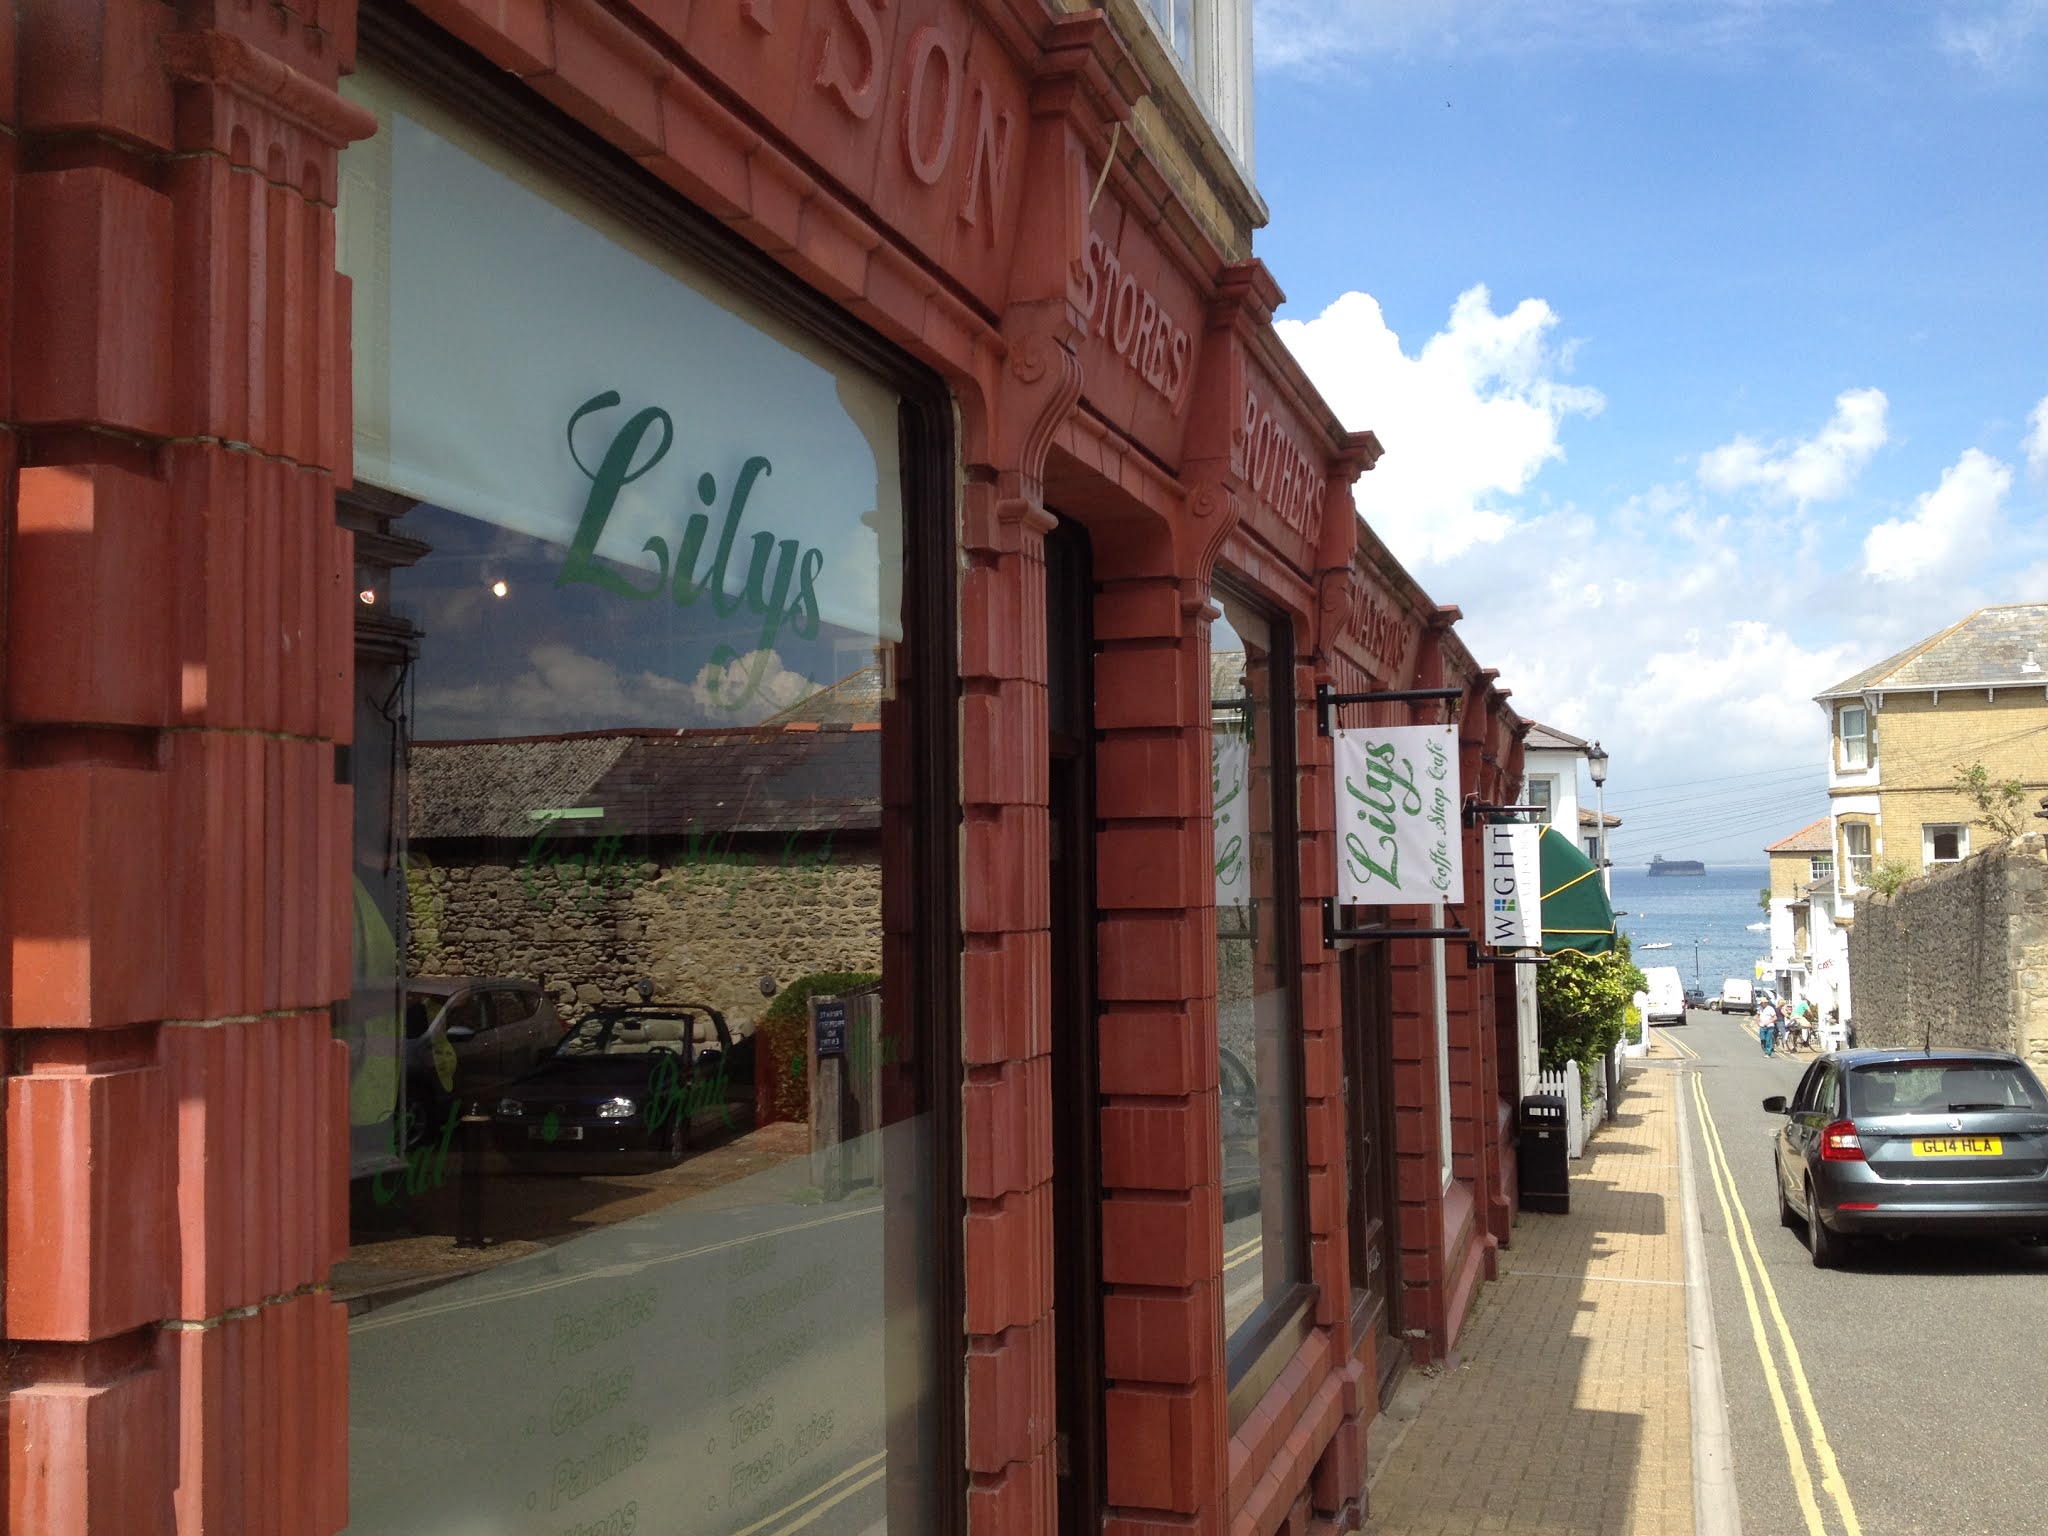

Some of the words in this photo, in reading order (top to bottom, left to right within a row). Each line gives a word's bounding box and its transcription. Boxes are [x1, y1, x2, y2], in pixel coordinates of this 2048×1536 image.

[742, 0, 1013, 248] SON
[1081, 231, 1187, 403] STORES
[1242, 388, 1323, 546] ROTHERS
[556, 390, 823, 711] Lilys
[1346, 741, 1421, 890] Lilys
[1427, 787, 1451, 836] Shop
[1430, 840, 1452, 891] Coffee
[1923, 1139, 1957, 1153] GL14
[1962, 1138, 1993, 1152] HLA
